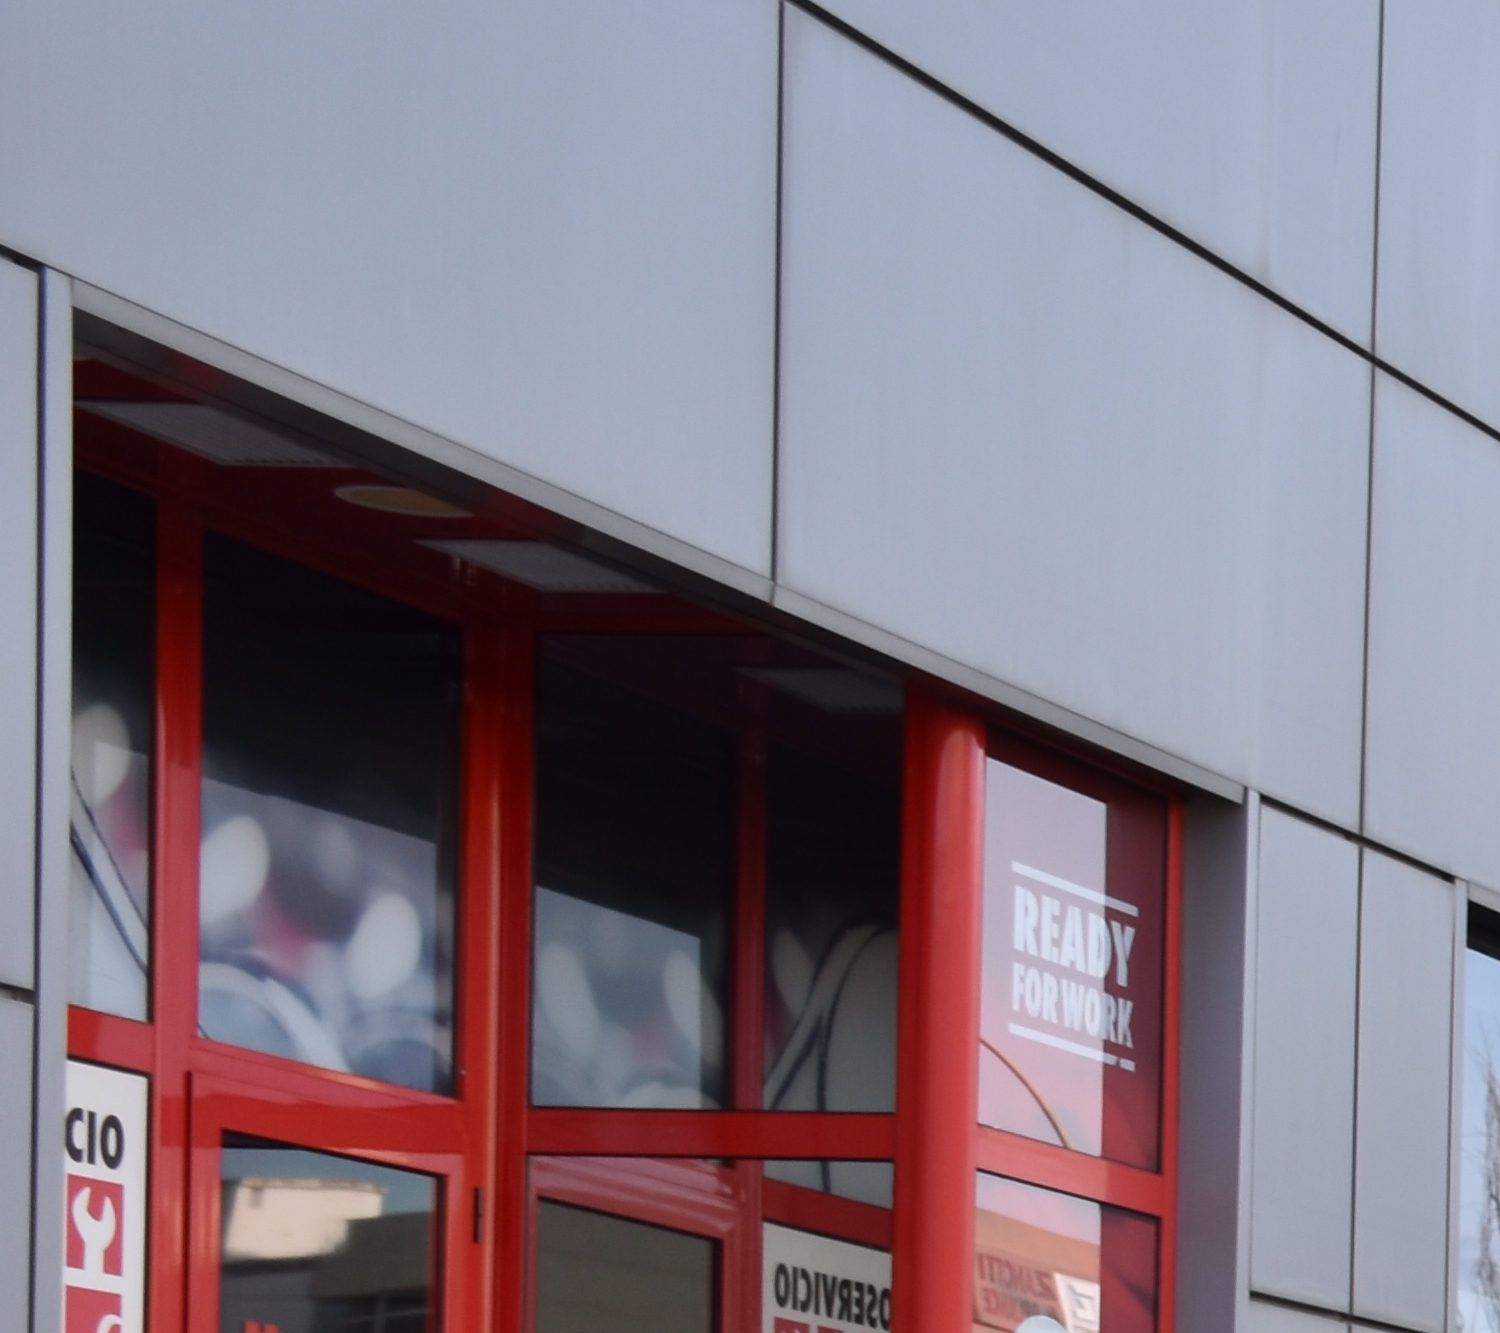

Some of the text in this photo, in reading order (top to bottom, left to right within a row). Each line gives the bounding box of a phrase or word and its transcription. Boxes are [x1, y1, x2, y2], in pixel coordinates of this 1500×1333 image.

[1013, 885, 1136, 988] READY
[1011, 961, 1134, 1050] FOR WORK
[65, 1107, 125, 1170] CIO
